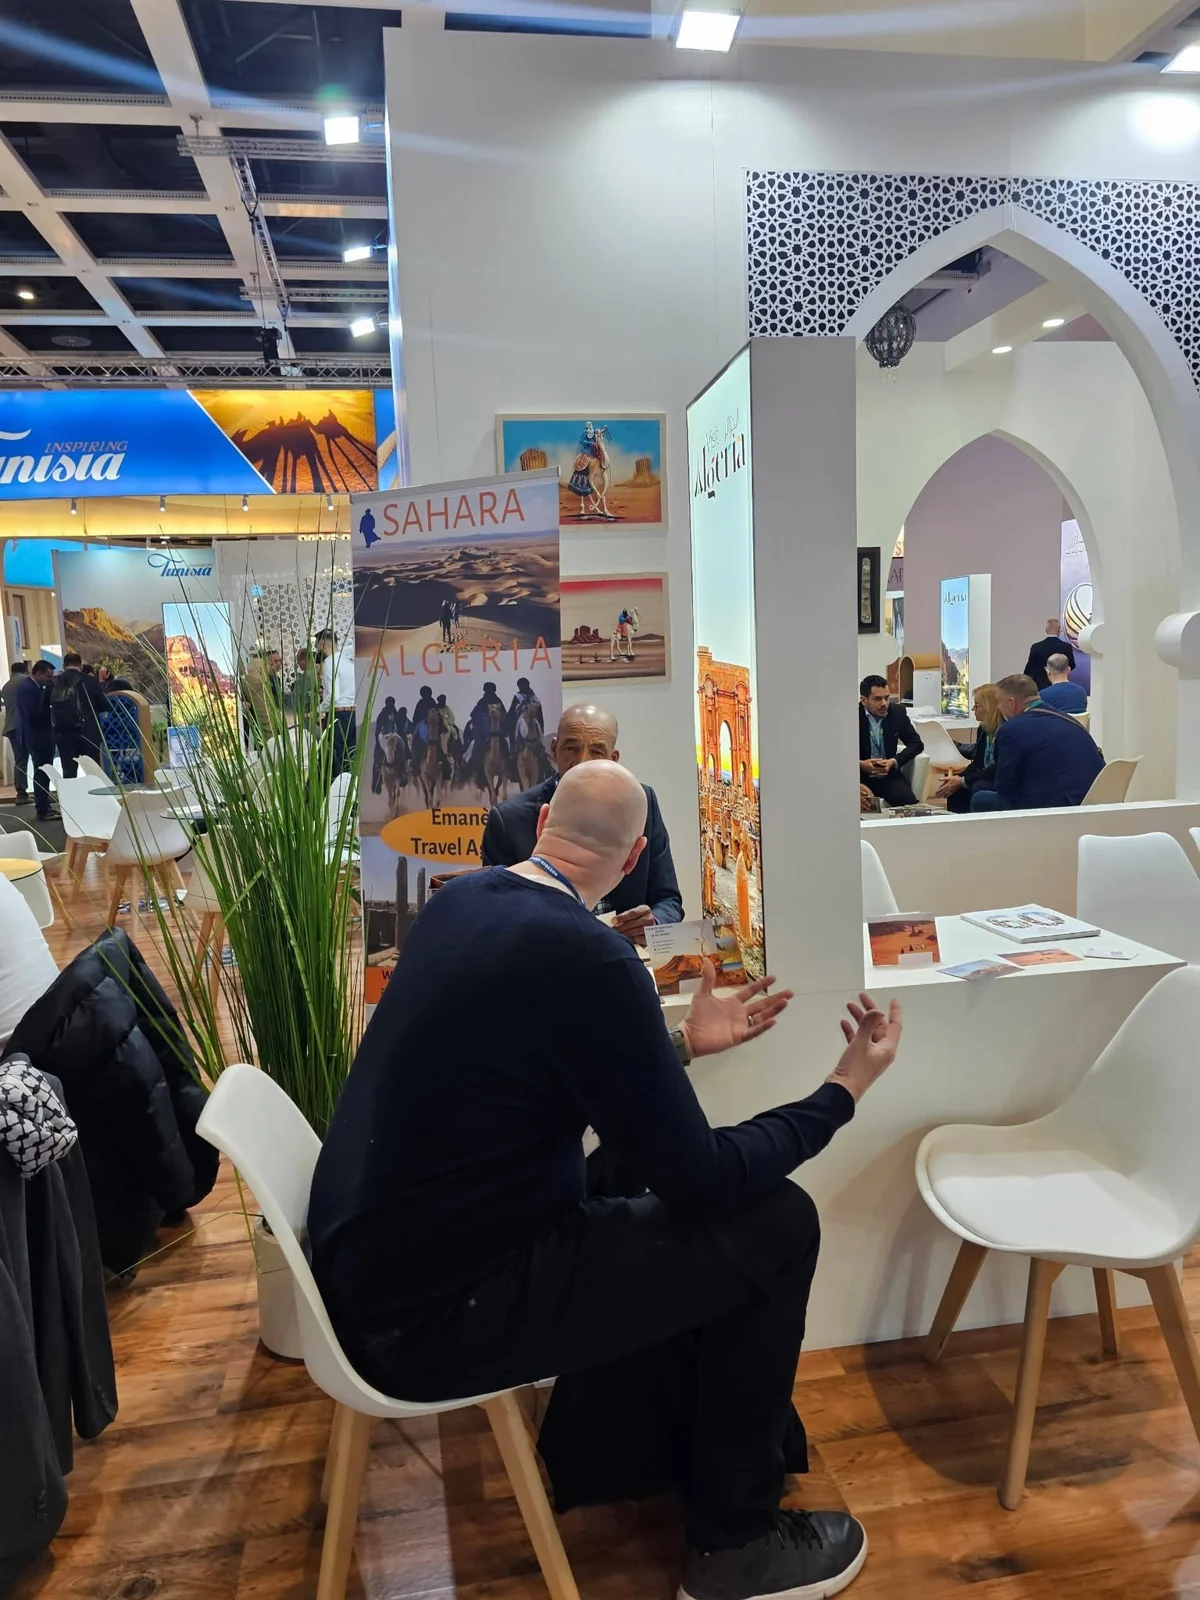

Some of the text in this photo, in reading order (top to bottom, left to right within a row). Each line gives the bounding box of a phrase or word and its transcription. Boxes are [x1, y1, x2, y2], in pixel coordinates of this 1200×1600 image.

[0, 429, 125, 485] nisia
[44, 440, 129, 453] INSPIRING
[383, 488, 525, 536] SAHARA
[147, 553, 213, 577] Tunisia
[367, 636, 552, 677] ALGERIA
[410, 837, 462, 856] Travel
